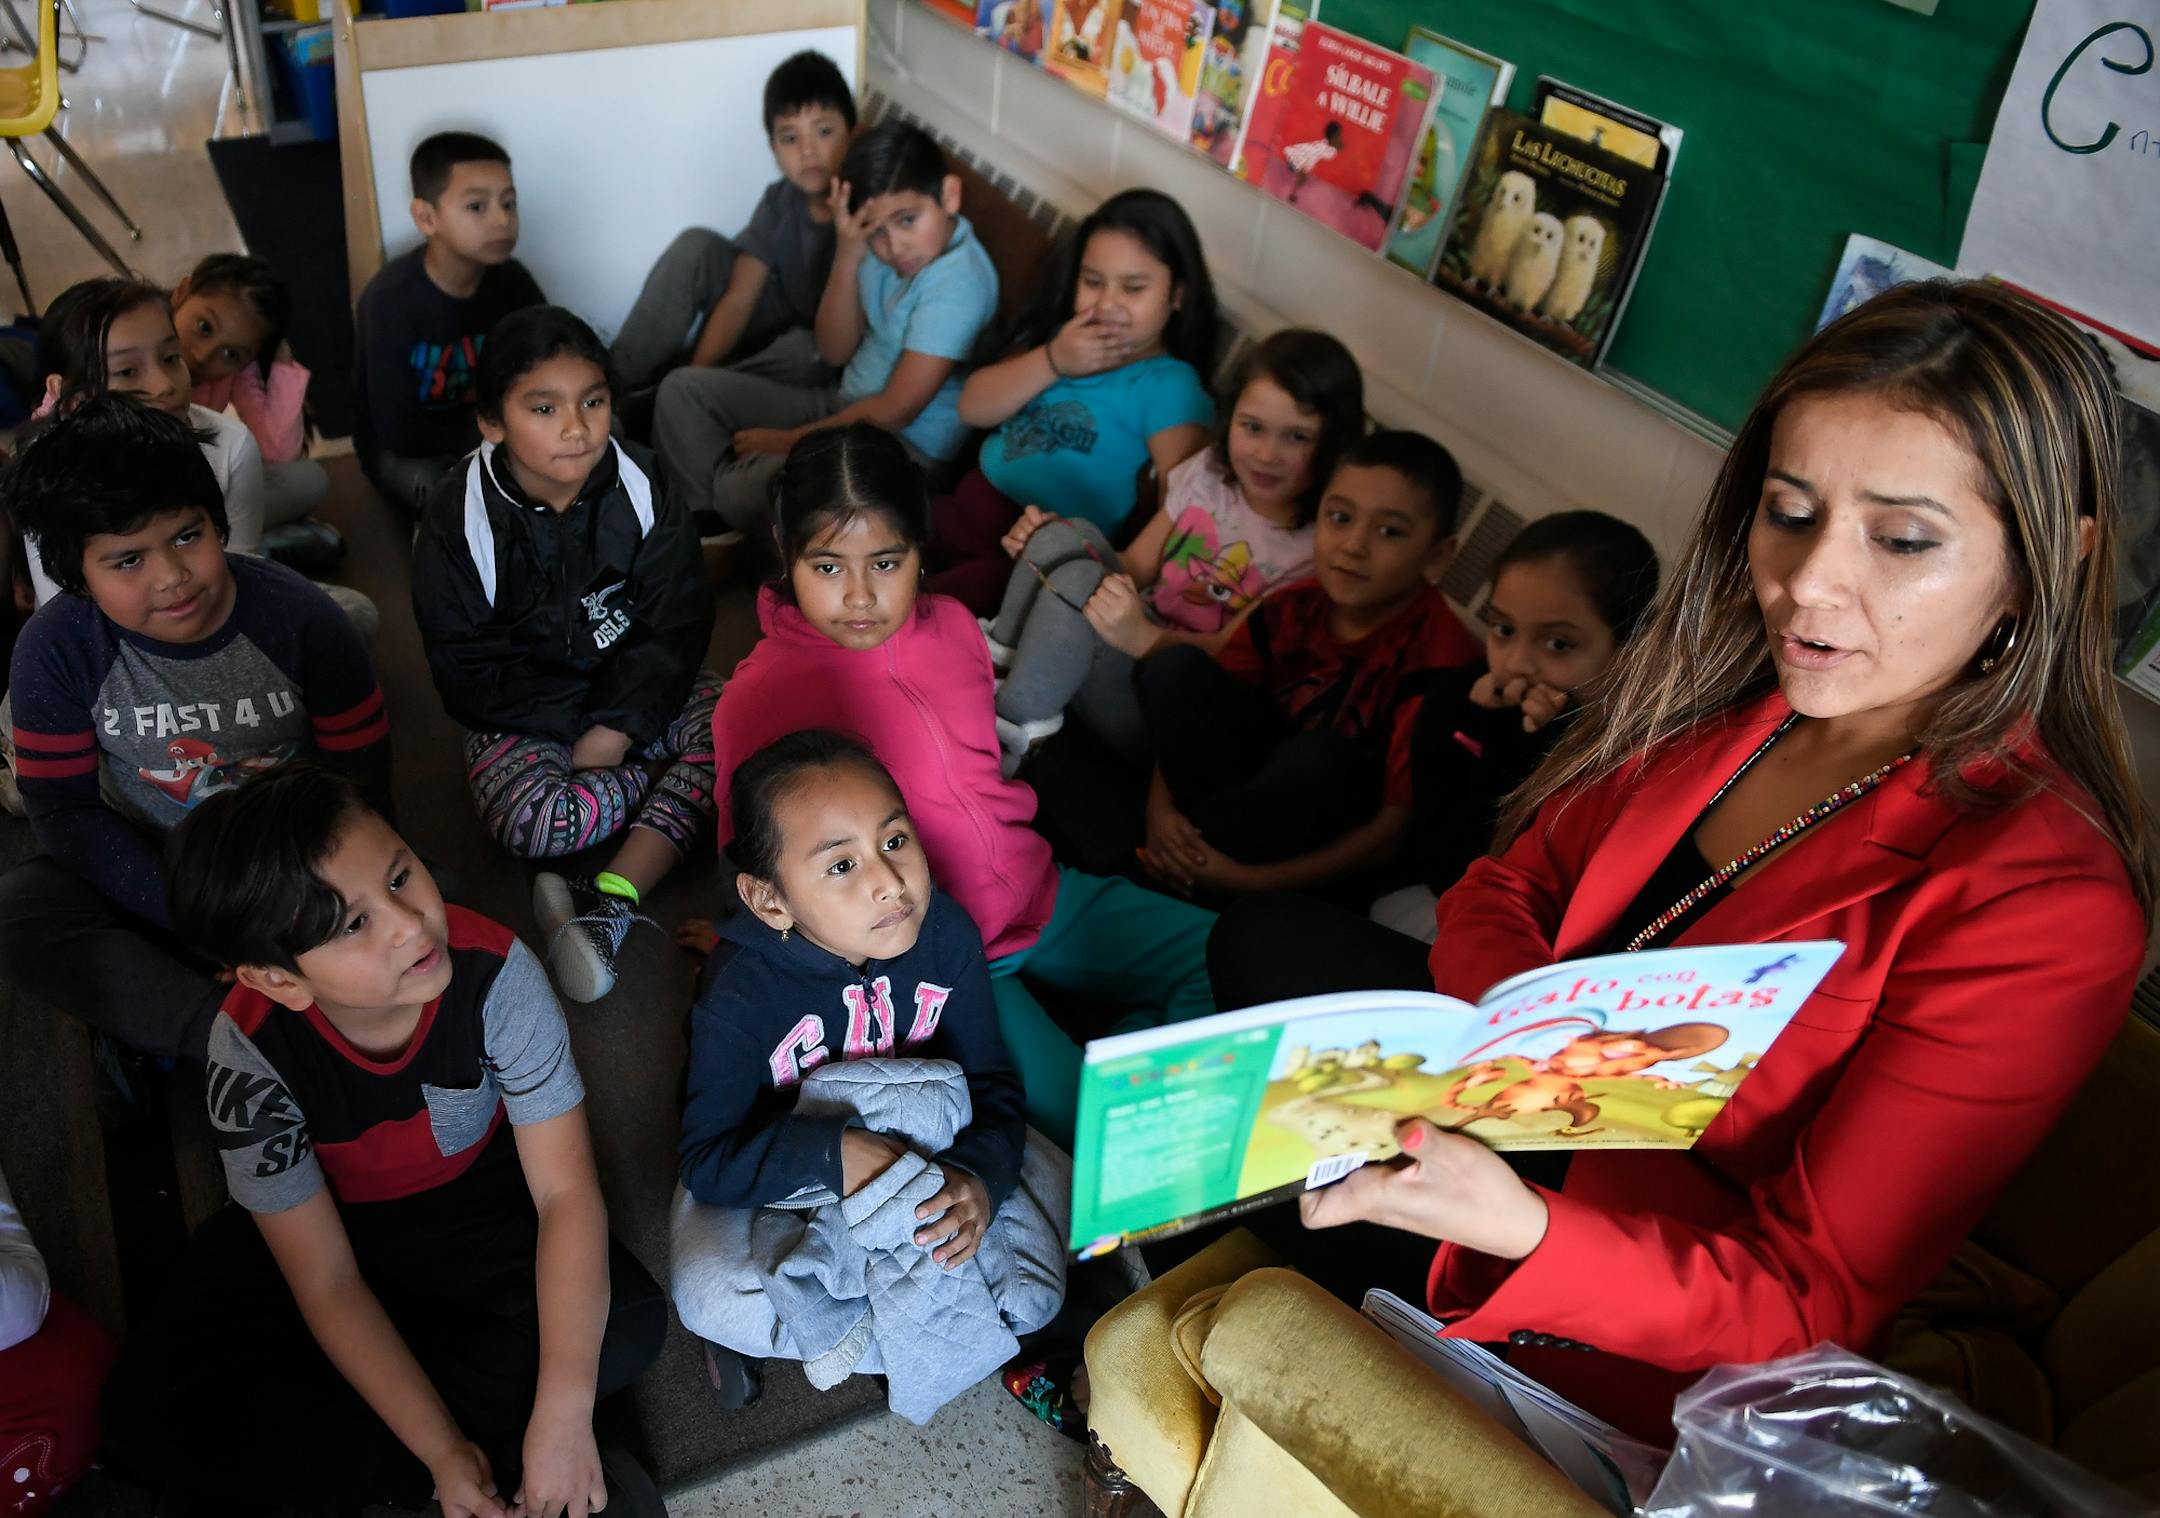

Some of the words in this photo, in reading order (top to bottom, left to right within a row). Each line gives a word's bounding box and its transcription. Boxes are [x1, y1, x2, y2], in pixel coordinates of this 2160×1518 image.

[1330, 91, 1387, 135] WILLIE
[104, 708, 121, 736] 2
[134, 702, 220, 738] FAST
[235, 697, 261, 728] 4
[267, 691, 295, 718] U
